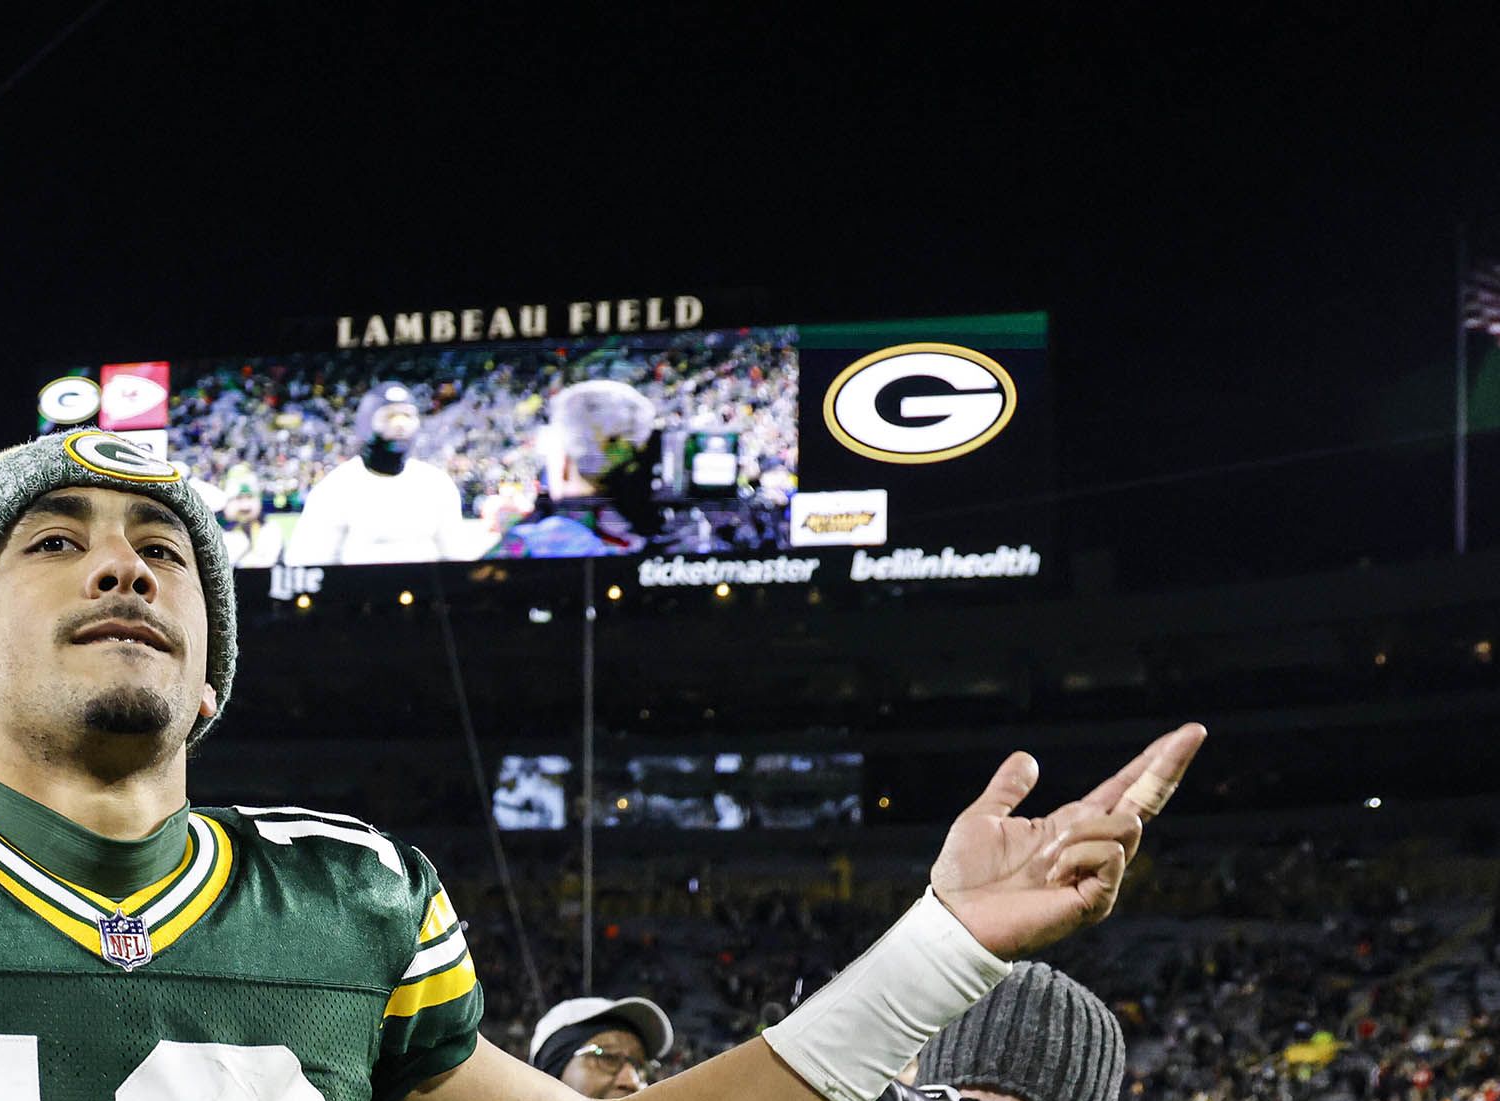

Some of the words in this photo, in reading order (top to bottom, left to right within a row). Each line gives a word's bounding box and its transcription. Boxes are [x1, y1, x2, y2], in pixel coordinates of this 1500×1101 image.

[336, 303, 549, 349] LAMBEAU
[567, 296, 704, 336] FIELD
[638, 556, 820, 587] ticketmaster
[109, 934, 146, 960] NFL
